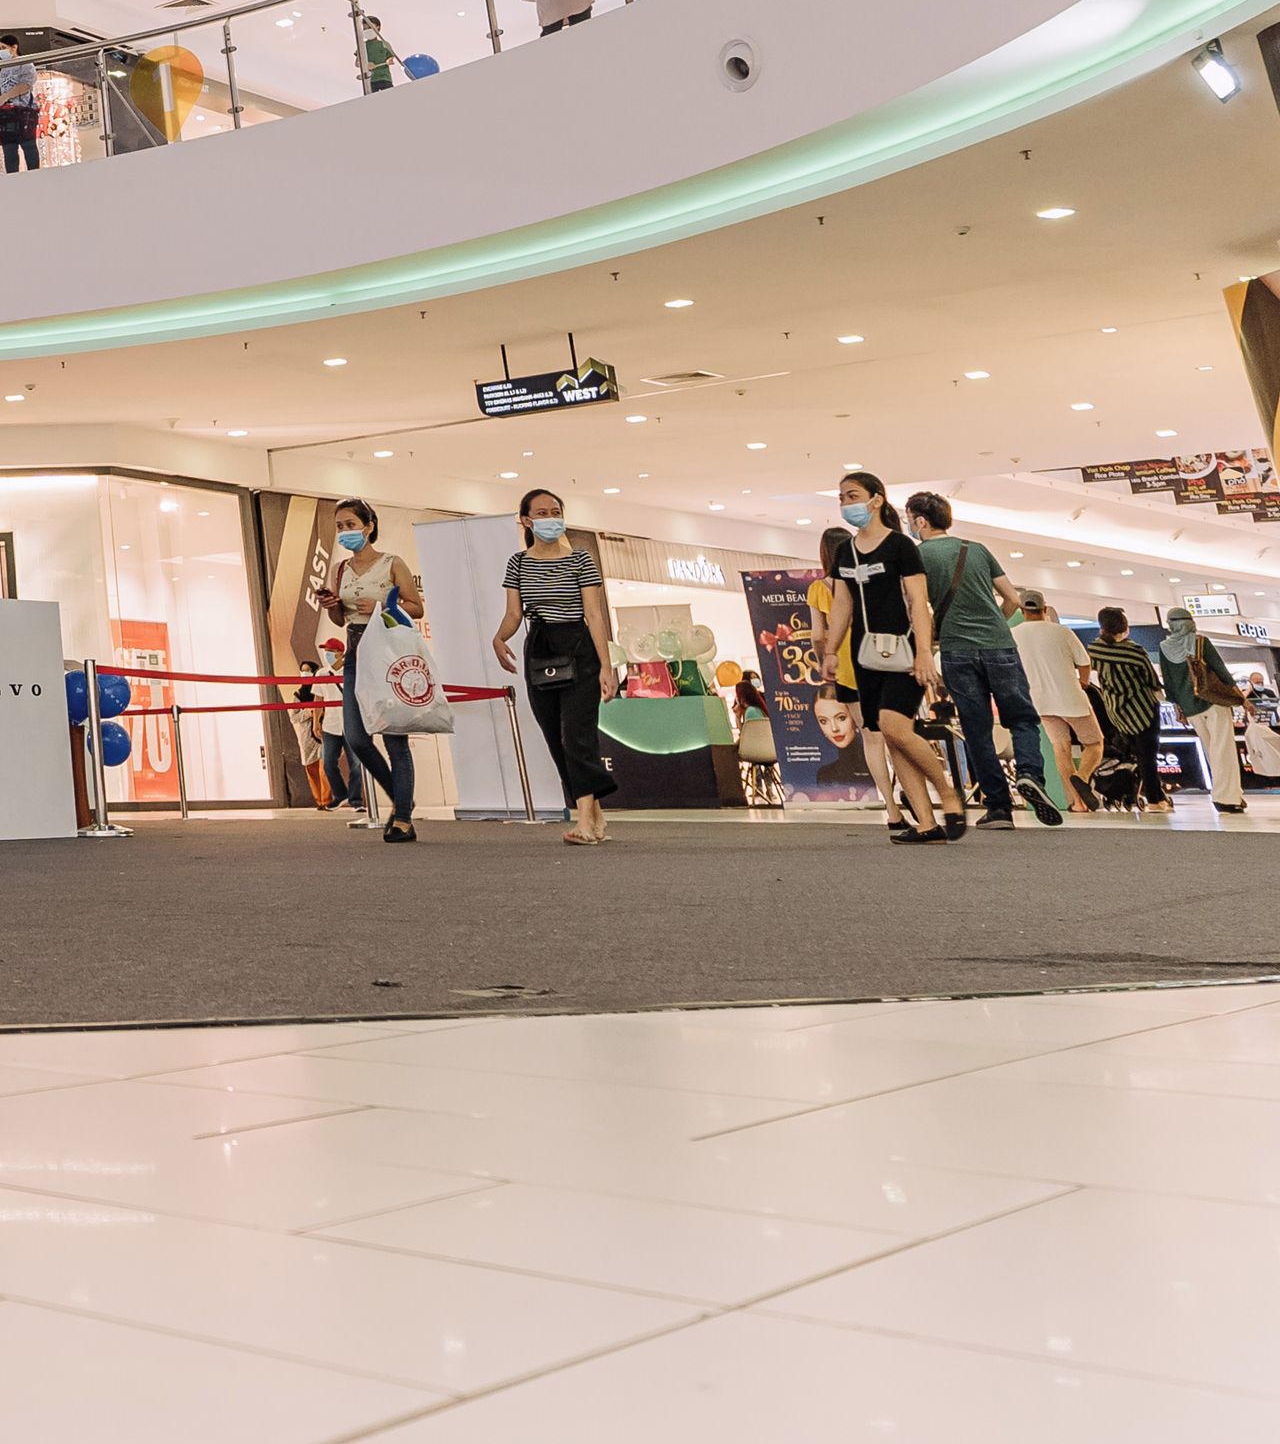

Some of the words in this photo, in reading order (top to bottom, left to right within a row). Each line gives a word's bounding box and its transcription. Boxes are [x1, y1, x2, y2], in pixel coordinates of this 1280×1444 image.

[562, 386, 599, 403] WEST
[305, 539, 330, 613] EAST
[671, 559, 726, 583] PANDORA
[761, 593, 785, 603] MEDI
[391, 661, 409, 677] MR
